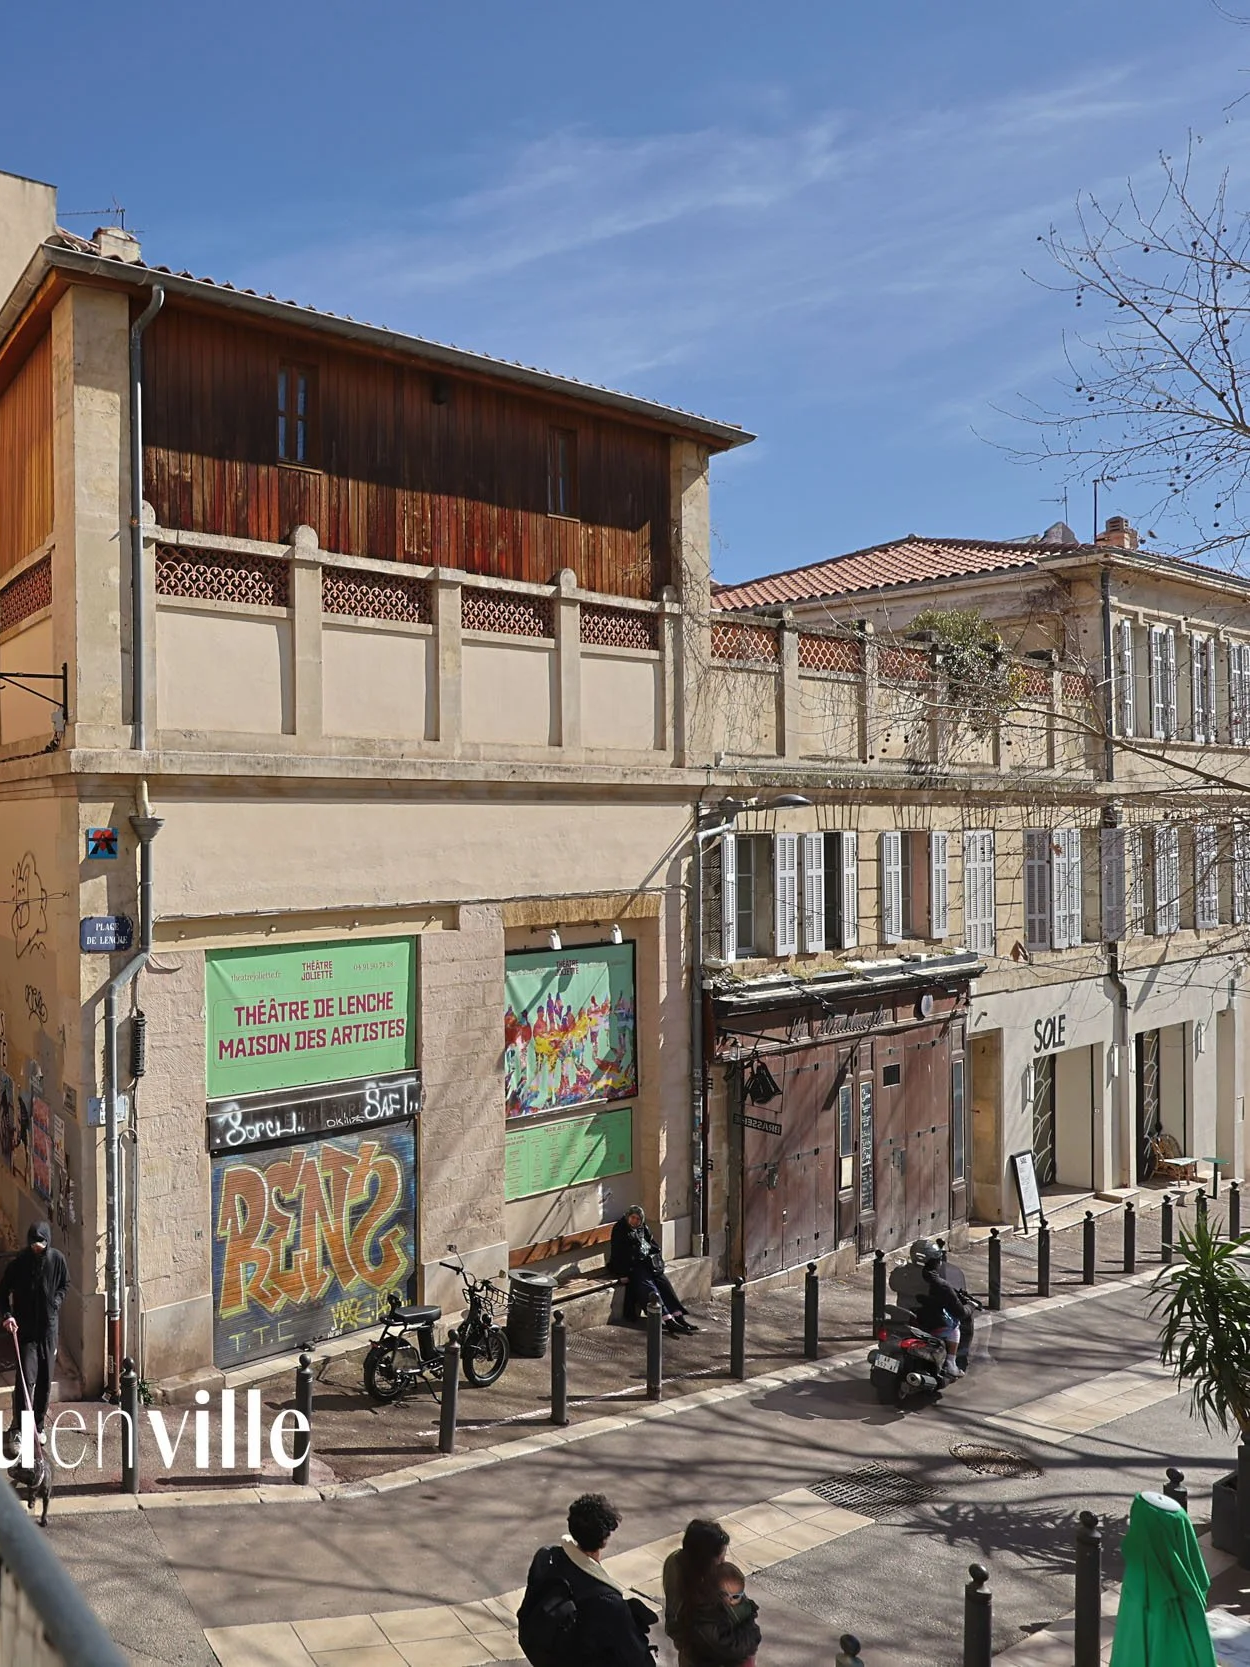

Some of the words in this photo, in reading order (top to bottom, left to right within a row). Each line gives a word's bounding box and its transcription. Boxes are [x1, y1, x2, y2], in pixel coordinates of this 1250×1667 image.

[95, 922, 120, 931] PLACE
[86, 936, 97, 945] DE
[301, 970, 334, 981] JOLIETTE
[234, 998, 309, 1027] THÉÂTRE
[313, 997, 334, 1018] DE
[339, 991, 394, 1016] LENCHE
[218, 1032, 290, 1060] MAISON
[294, 1028, 327, 1051] DES
[331, 1018, 405, 1046] ARTISTES
[1033, 1014, 1067, 1053] SOLE
